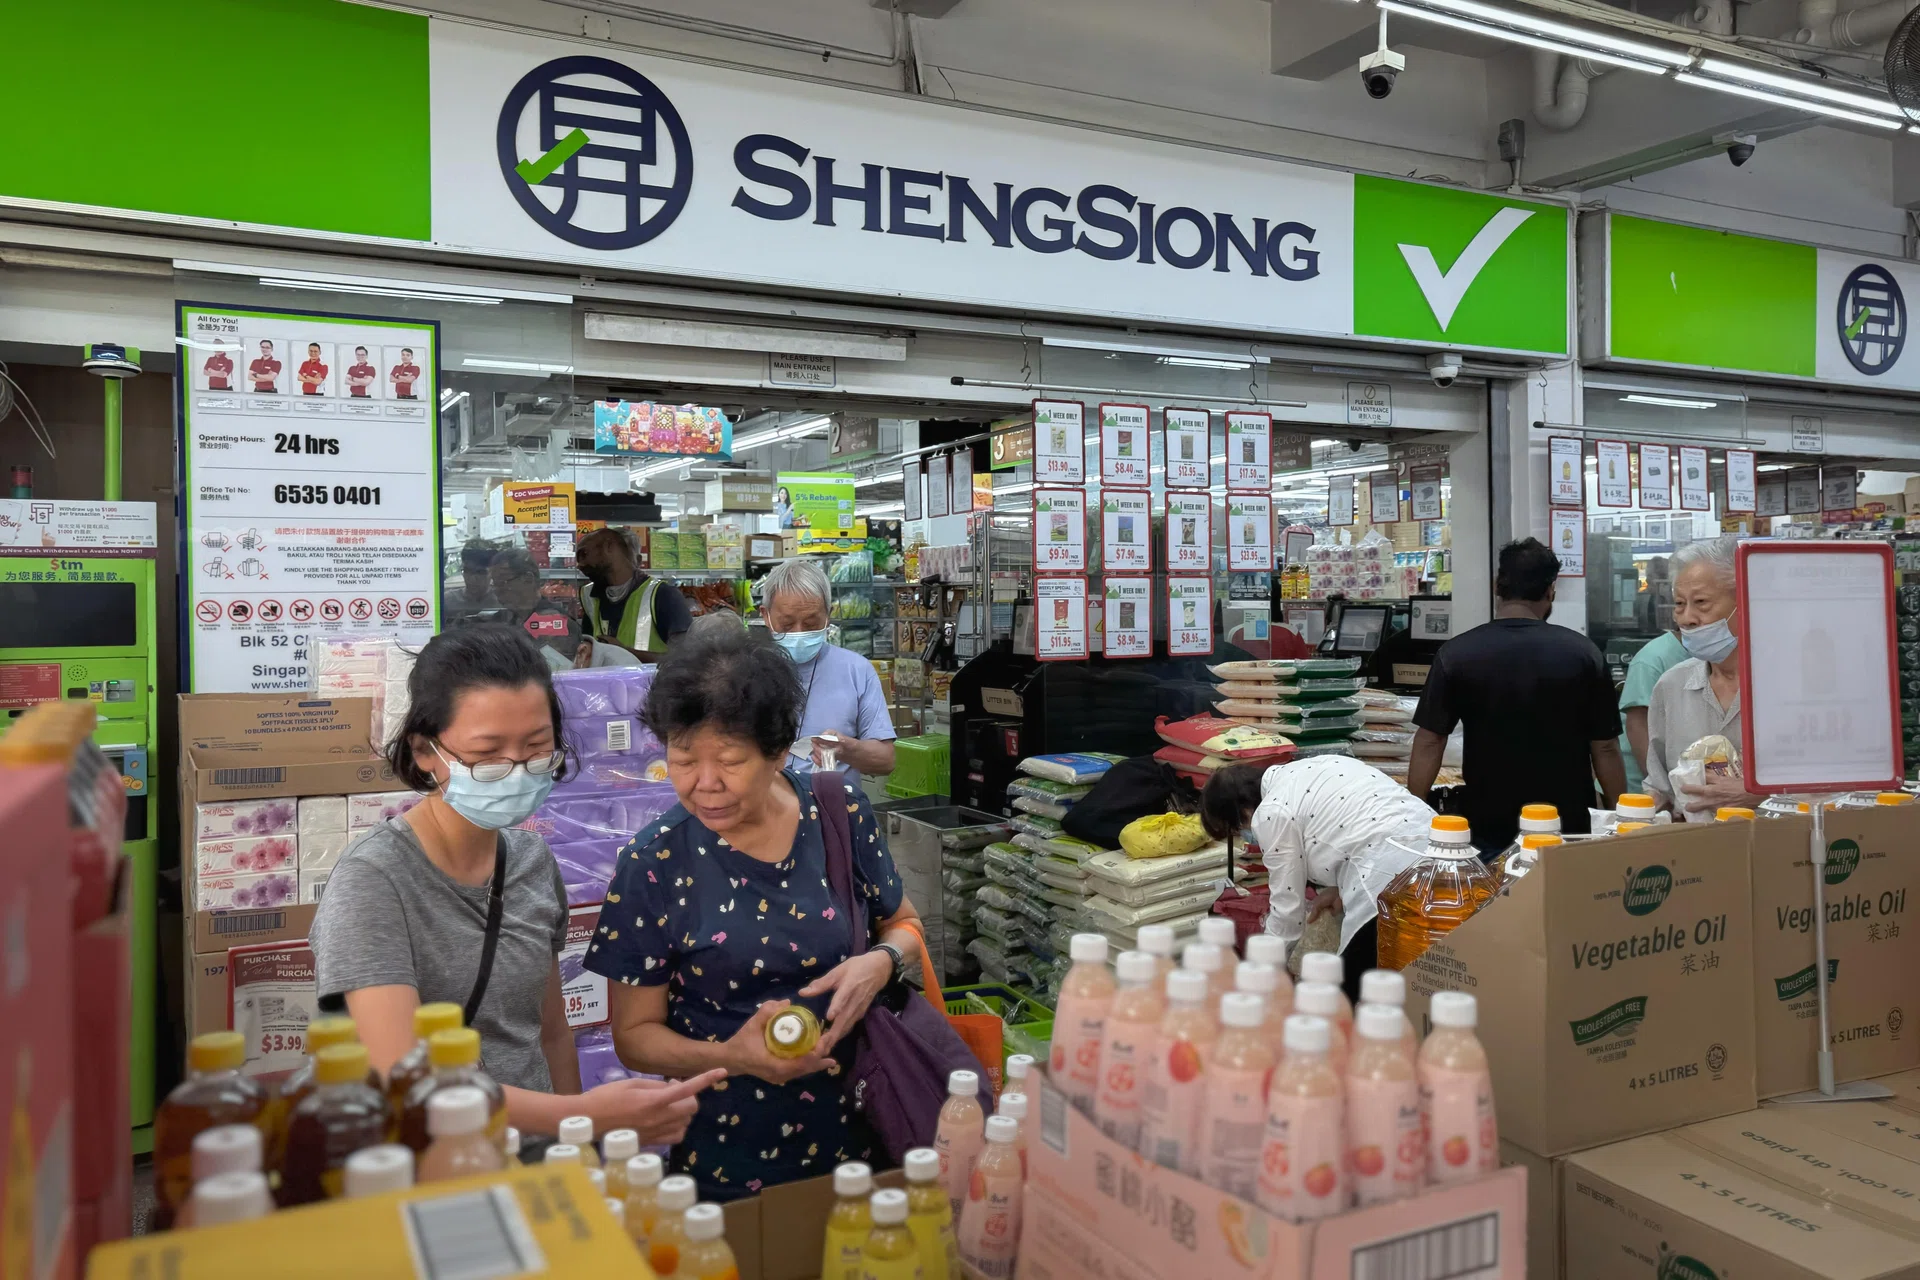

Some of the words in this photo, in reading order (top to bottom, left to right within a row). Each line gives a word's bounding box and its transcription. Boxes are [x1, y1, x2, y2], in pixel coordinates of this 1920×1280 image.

[780, 354, 808, 362] PLEASE
[809, 355, 824, 363] USE
[773, 361, 792, 370] MAIN
[793, 362, 832, 372] ENTRANCE
[1053, 412, 1065, 420] WEEK
[1120, 415, 1131, 423] WEEK
[1194, 420, 1204, 428] ONLY
[198, 434, 239, 443] Operating
[240, 435, 266, 443] Hours:
[274, 433, 301, 454] 24
[305, 434, 340, 455] hrs
[831, 422, 842, 453] 2
[994, 434, 1005, 460] 3
[1409, 444, 1437, 456] CHECK
[1048, 459, 1068, 472] $13.90
[1115, 461, 1134, 474] $8.40
[1178, 465, 1196, 477] $12.95
[1239, 467, 1257, 479] $17.50
[200, 486, 223, 494] Office
[225, 486, 236, 494] Tel
[274, 484, 329, 504] 6535
[333, 485, 381, 505] 0401
[527, 488, 551, 496] Voucher
[795, 493, 808, 501] 5%
[809, 493, 837, 501] Rebate
[517, 504, 548, 513] Accepted
[1048, 548, 1069, 560] $9.50
[1115, 548, 1135, 560] $7.90
[1179, 549, 1197, 560] $9.90
[1240, 550, 1258, 561] $23.95
[240, 635, 266, 647] Blk
[271, 635, 289, 647] 52
[1050, 635, 1071, 648] $11.95
[1117, 633, 1136, 647] $8.90
[1181, 632, 1199, 644] $8.95
[986, 695, 1003, 705] LITTER
[1631, 874, 1671, 891] happy
[1680, 876, 1703, 886] NATURAL
[1627, 885, 1669, 907] family
[1776, 894, 1871, 934] Vegtable
[1878, 888, 1907, 915] Oil
[1866, 920, 1901, 944] 菜油
[1572, 923, 1686, 971] Vegetable
[1694, 914, 1727, 946] Oil
[243, 954, 291, 964] PURCHASE
[1425, 951, 1467, 972] MARKETING
[1680, 950, 1720, 976] 菜油
[1422, 973, 1445, 990] Mandai
[1449, 969, 1463, 982] PTE
[1464, 974, 1478, 987] LTD
[587, 1001, 599, 1009] SET
[1576, 1007, 1624, 1035] CHOLESTEROL
[1625, 1001, 1641, 1013] FREE
[1838, 1031, 1845, 1042] 5
[1846, 1024, 1881, 1041] LITRES
[261, 1034, 302, 1054] $3.99
[1586, 1045, 1604, 1056] TANPA
[1604, 1038, 1637, 1053] KOLESTEROL
[1629, 1077, 1637, 1090] 4
[1649, 1073, 1656, 1086] 5
[1659, 1062, 1699, 1084] LITRES
[1740, 1130, 1798, 1153] place
[1795, 1153, 1832, 1169] dry
[1837, 1168, 1889, 1189] cool,
[1576, 1182, 1591, 1197] BEST
[1678, 1172, 1699, 1181] 4
[1694, 1181, 1713, 1189] x
[1713, 1189, 1735, 1197] 5
[1732, 1197, 1823, 1233] LITRES
